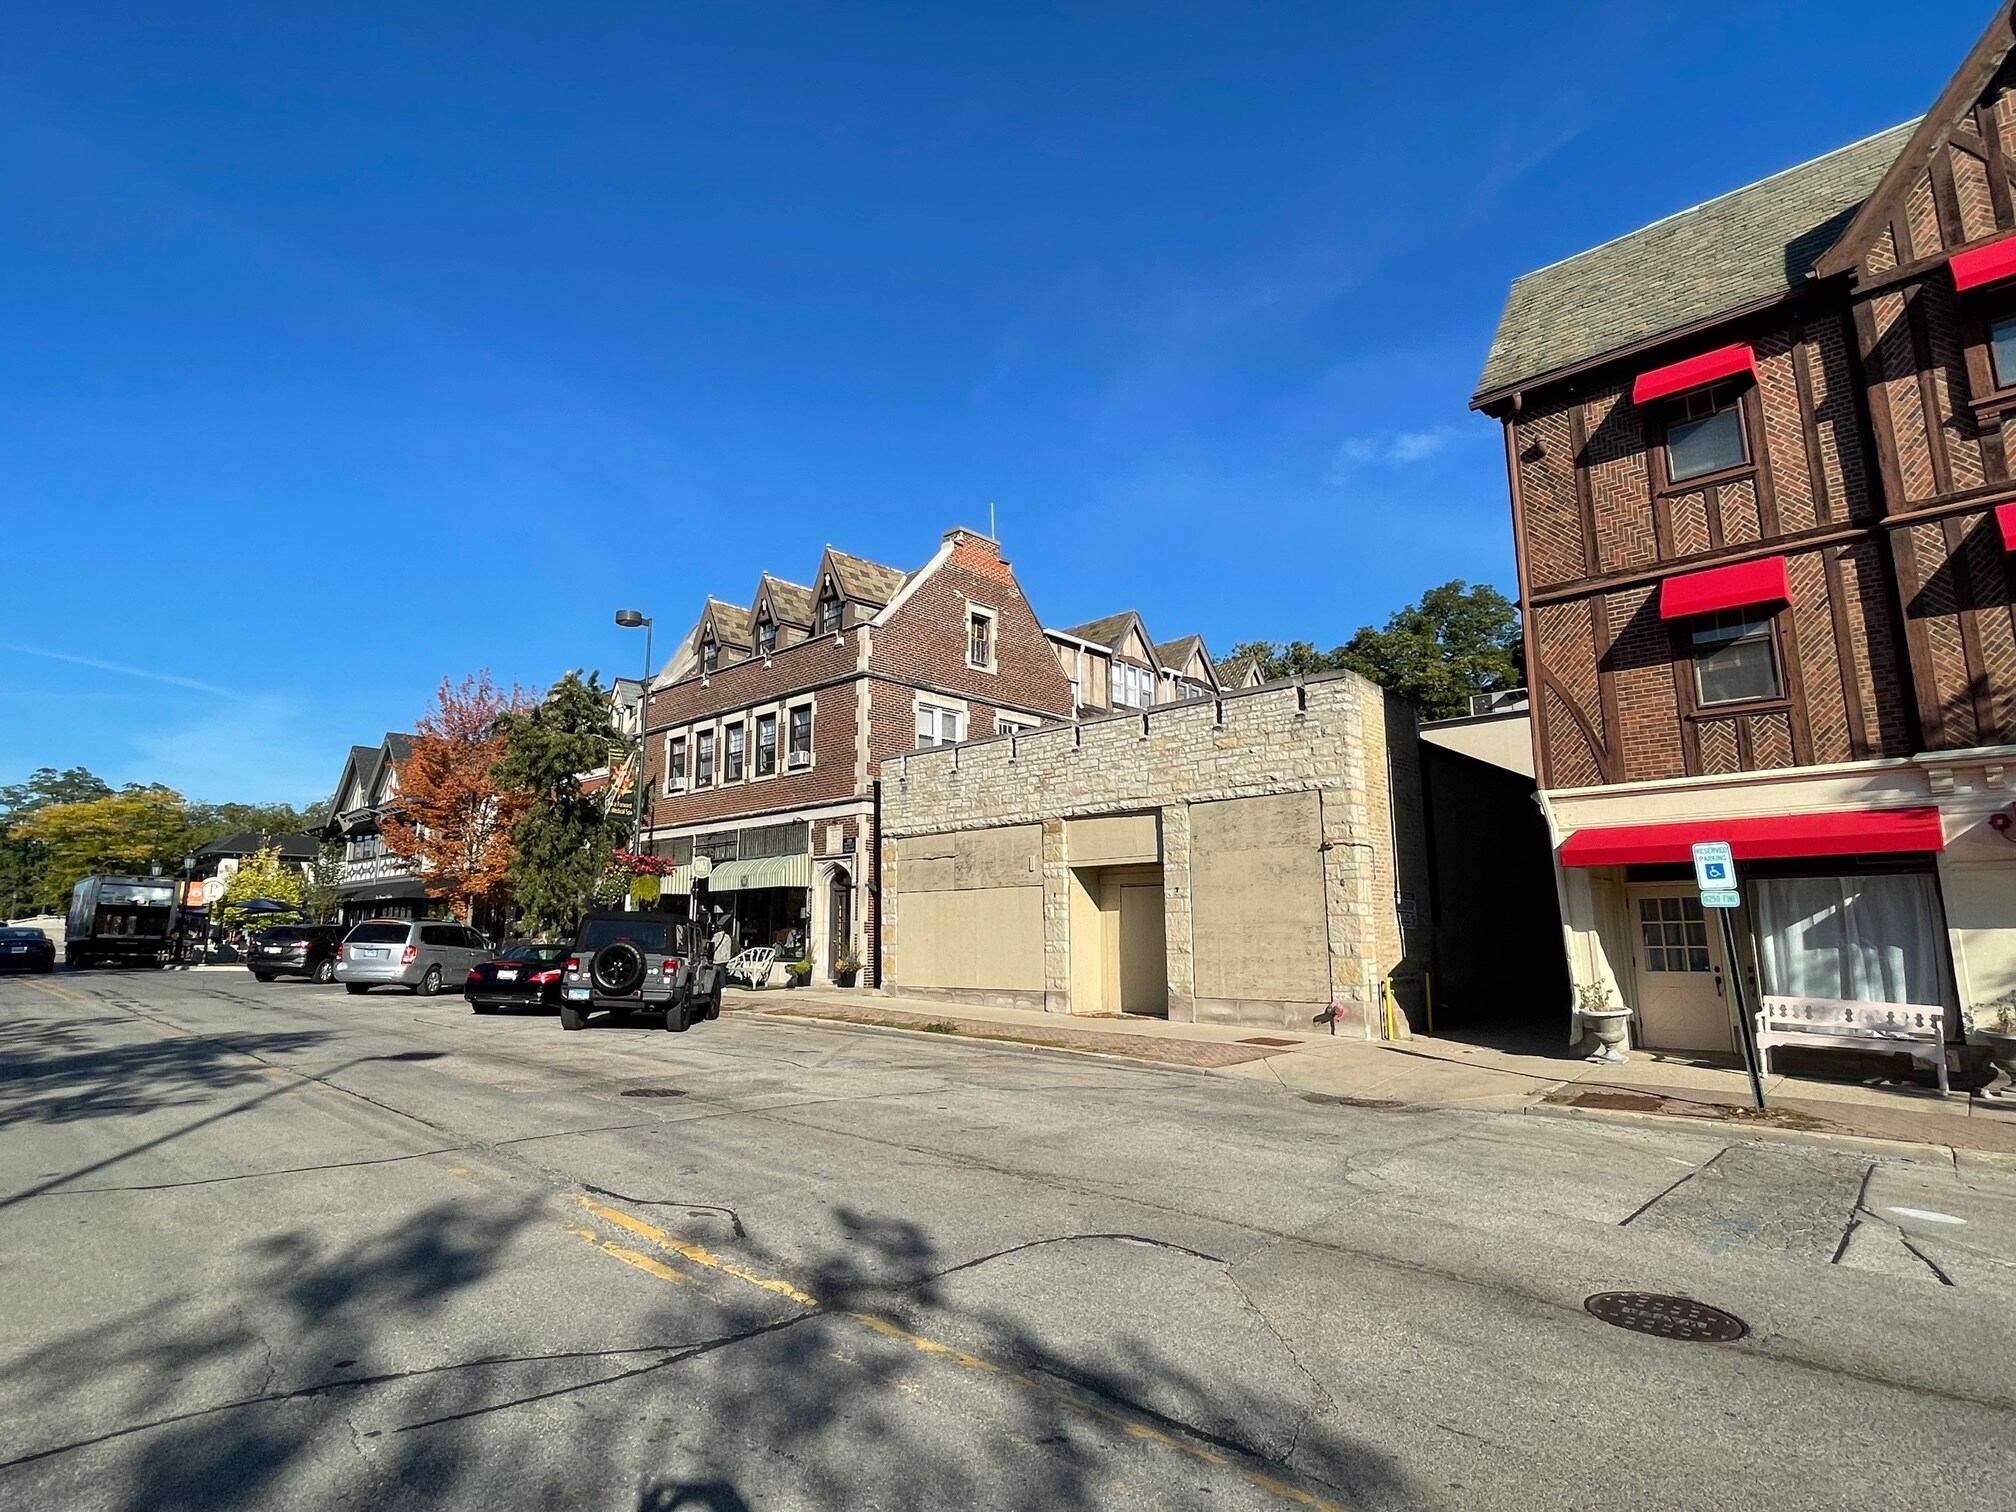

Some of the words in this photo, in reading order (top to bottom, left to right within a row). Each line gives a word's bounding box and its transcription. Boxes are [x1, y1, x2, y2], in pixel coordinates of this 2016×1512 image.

[209, 884, 218, 895] P
[1703, 895, 1721, 903] $250
[1723, 895, 1736, 903] FINE
